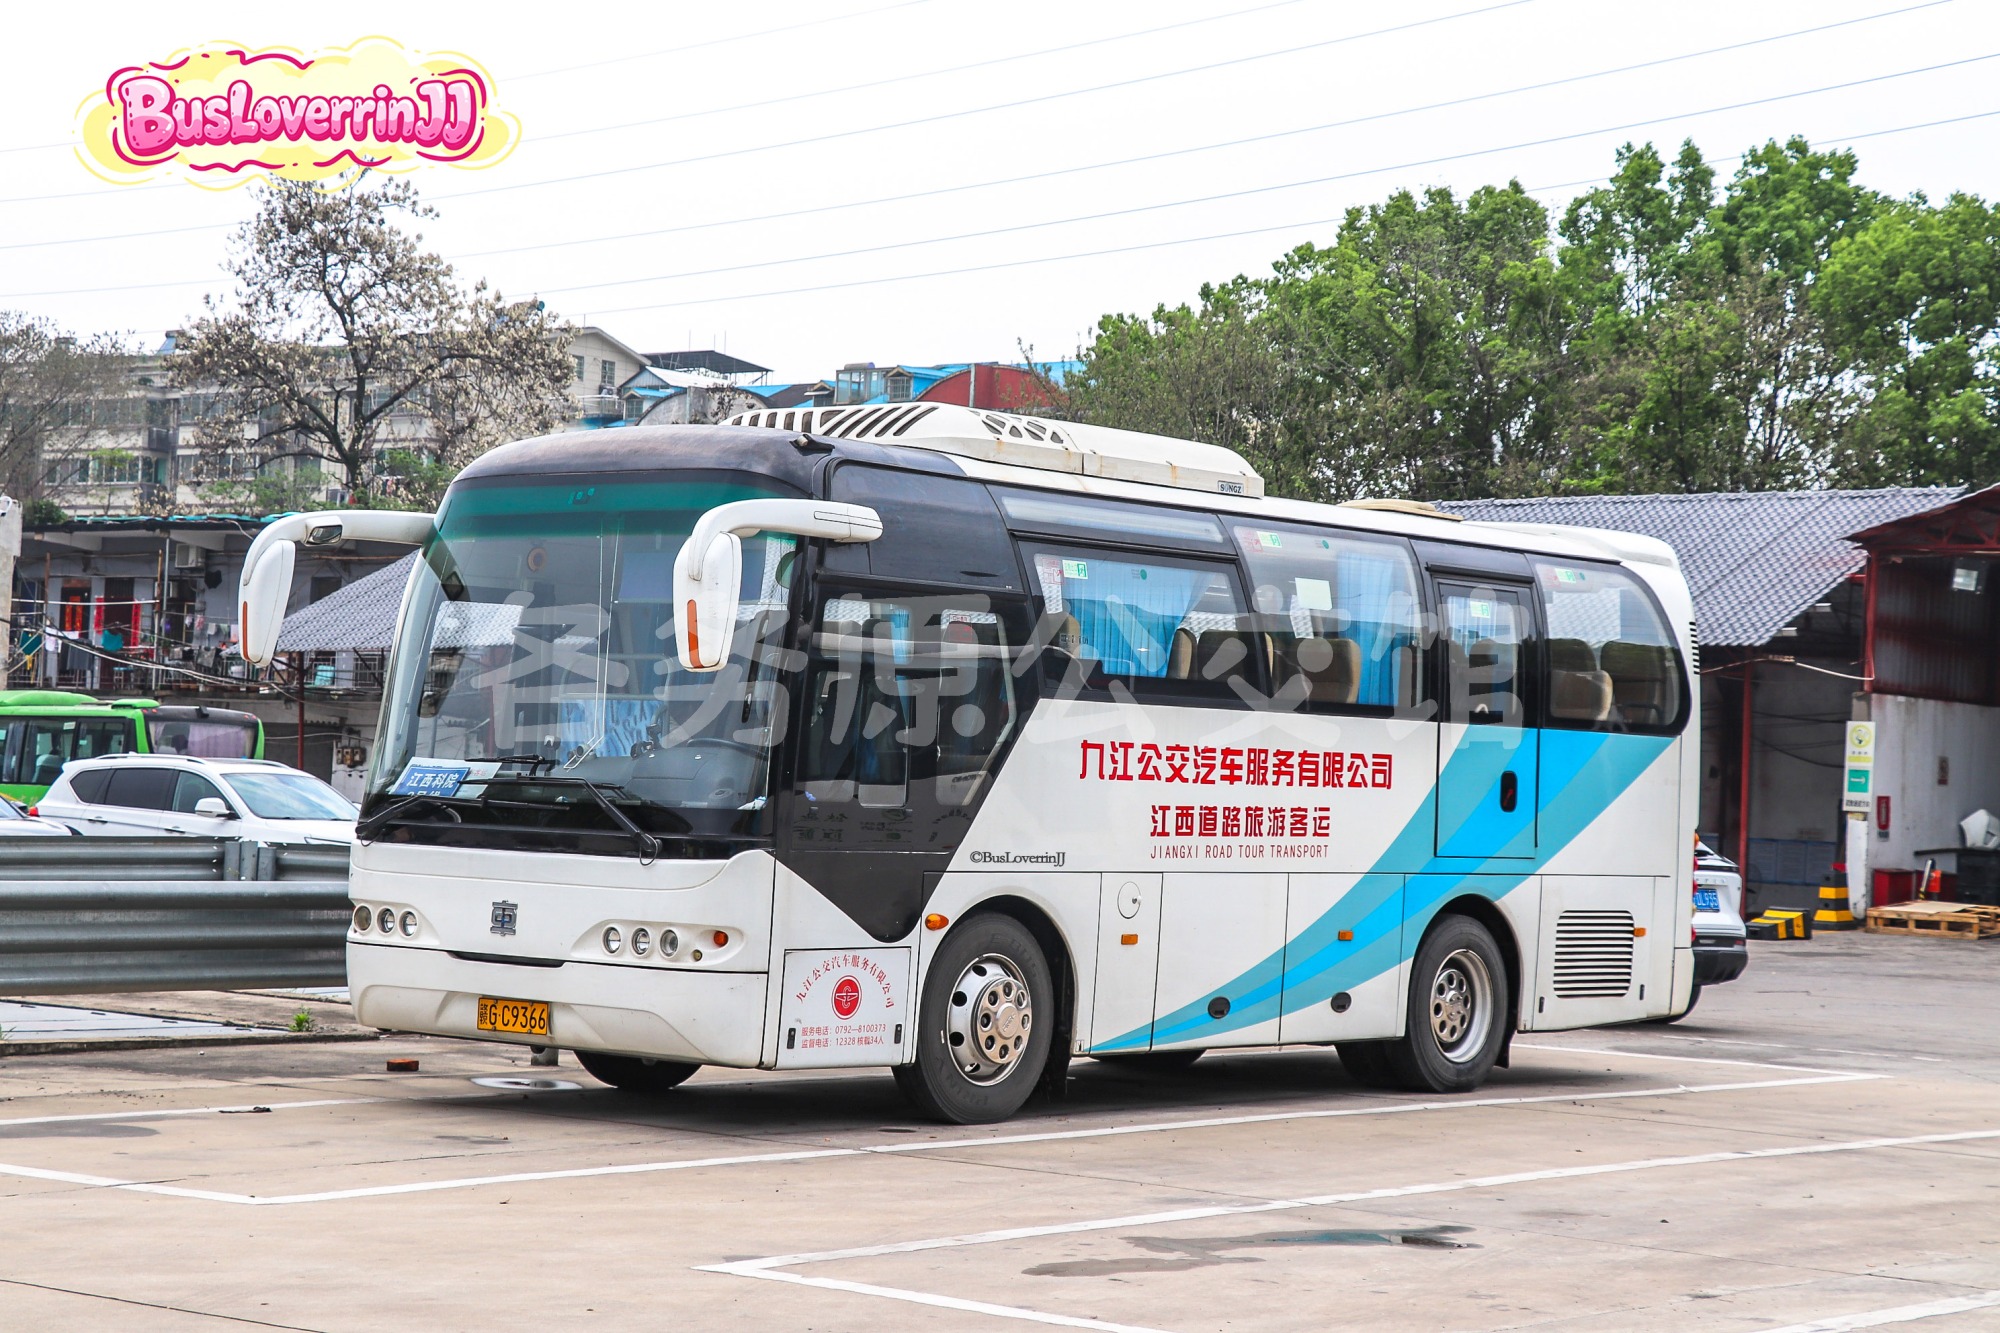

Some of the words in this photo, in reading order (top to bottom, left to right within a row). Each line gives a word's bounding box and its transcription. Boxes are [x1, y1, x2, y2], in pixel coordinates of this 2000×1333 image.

[1220, 484, 1242, 494] SONGZ
[1079, 739, 1393, 790] 九江公交汽车服务有限公司
[406, 772, 460, 789] 江西科院
[1150, 804, 1331, 838] 江西道路旅游客运
[1150, 845, 1199, 859] JIANGXI
[1205, 845, 1233, 859] ROAD
[1238, 844, 1265, 858] TOUR
[1270, 845, 1329, 859] TRANSPORT
[796, 954, 895, 1009] 九江公交汽车服务有限公司
